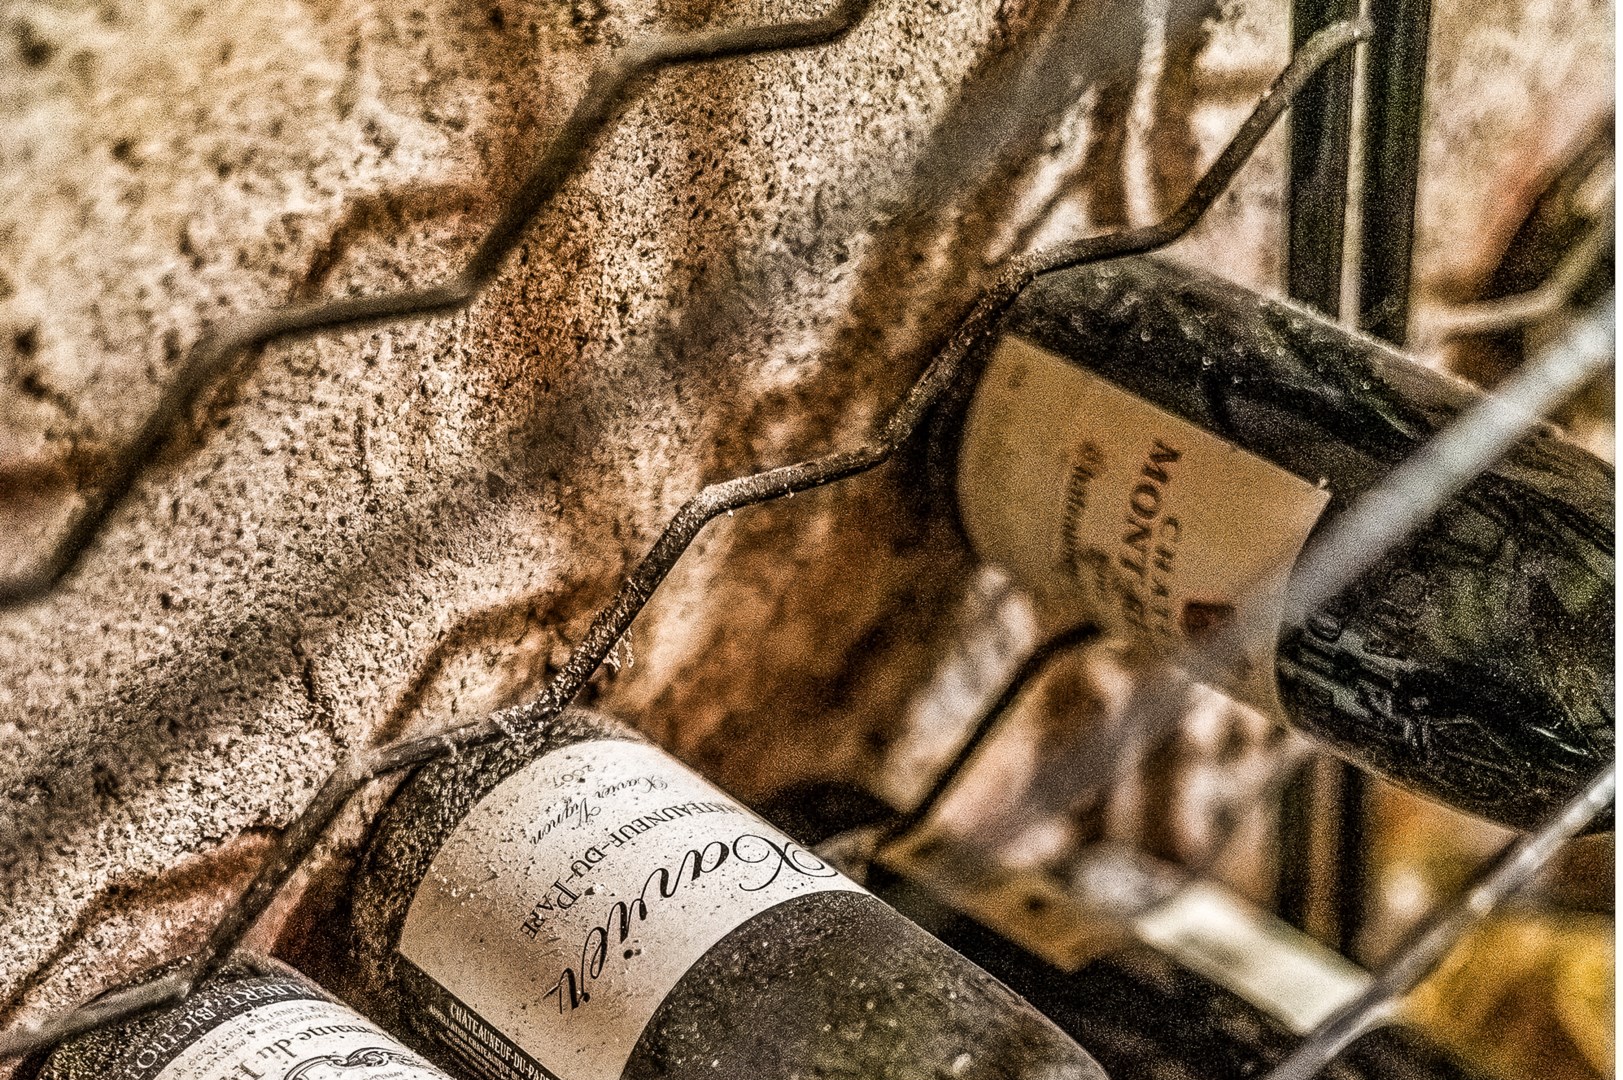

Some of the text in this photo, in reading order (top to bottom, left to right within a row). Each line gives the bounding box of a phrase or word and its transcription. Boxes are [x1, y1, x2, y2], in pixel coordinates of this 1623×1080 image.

[552, 764, 595, 789] 2007
[528, 774, 668, 848] Xavier Vignon
[542, 835, 838, 1014] Xavier
[296, 1025, 384, 1043] maine
[255, 1035, 301, 1063] du
